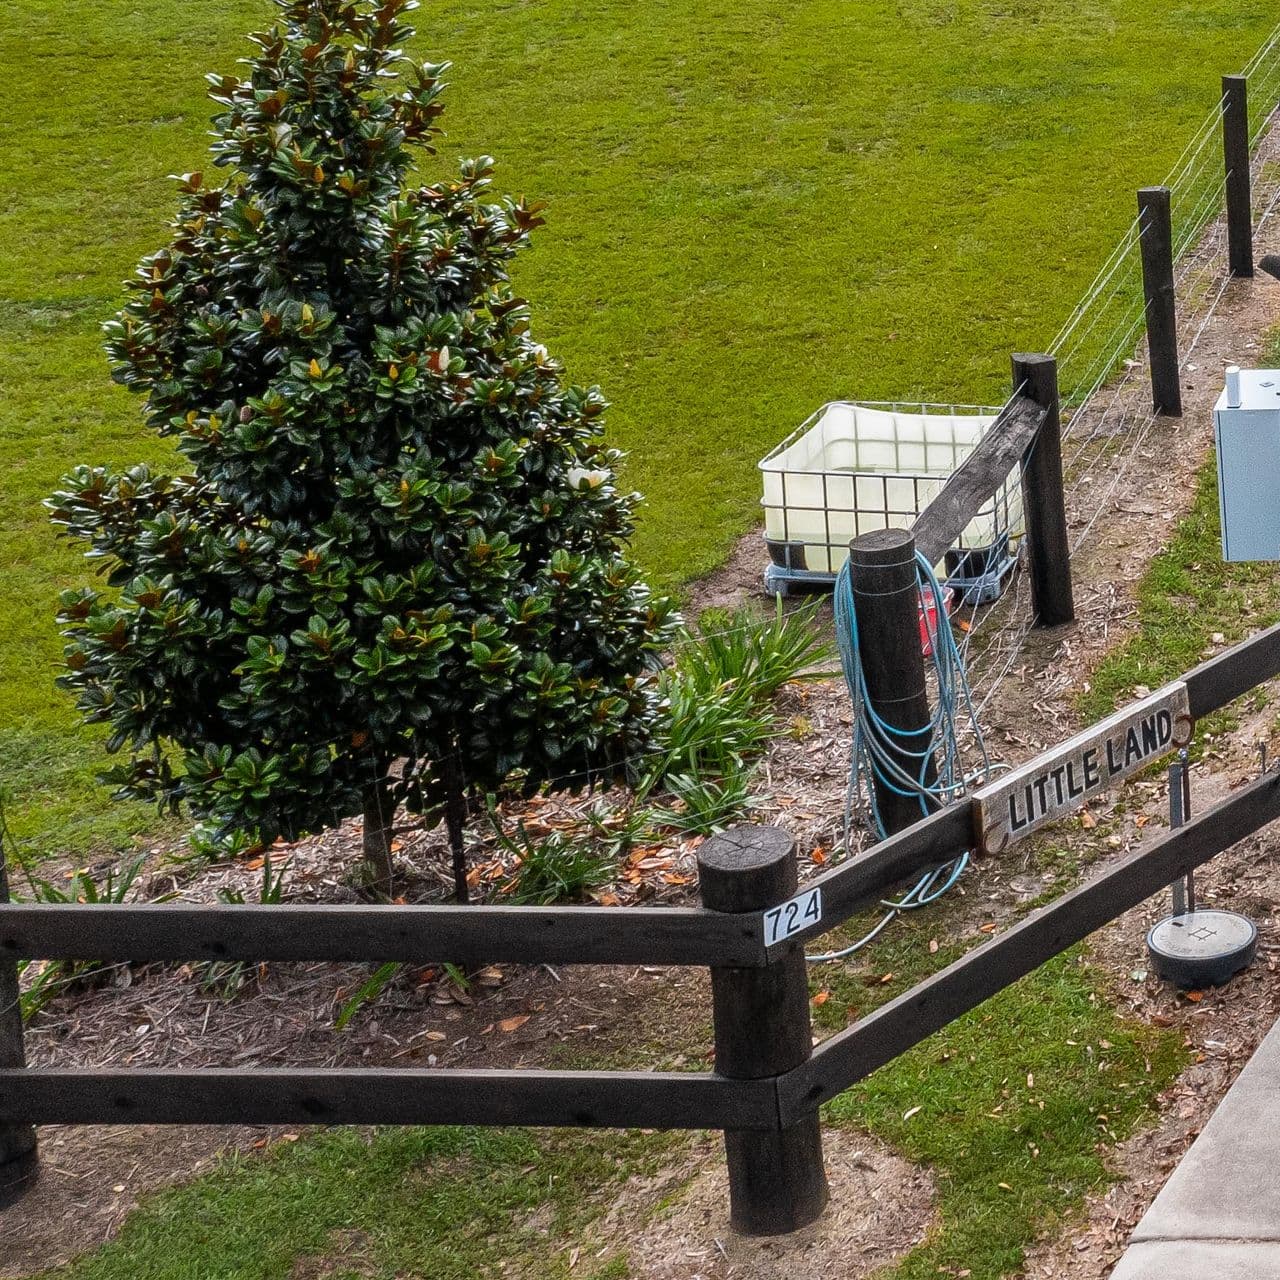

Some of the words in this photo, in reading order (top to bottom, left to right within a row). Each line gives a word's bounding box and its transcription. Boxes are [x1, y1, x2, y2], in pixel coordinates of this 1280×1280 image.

[1009, 748, 1099, 832] LITTLE
[1107, 709, 1171, 776] LAND
[766, 890, 819, 941] 724
